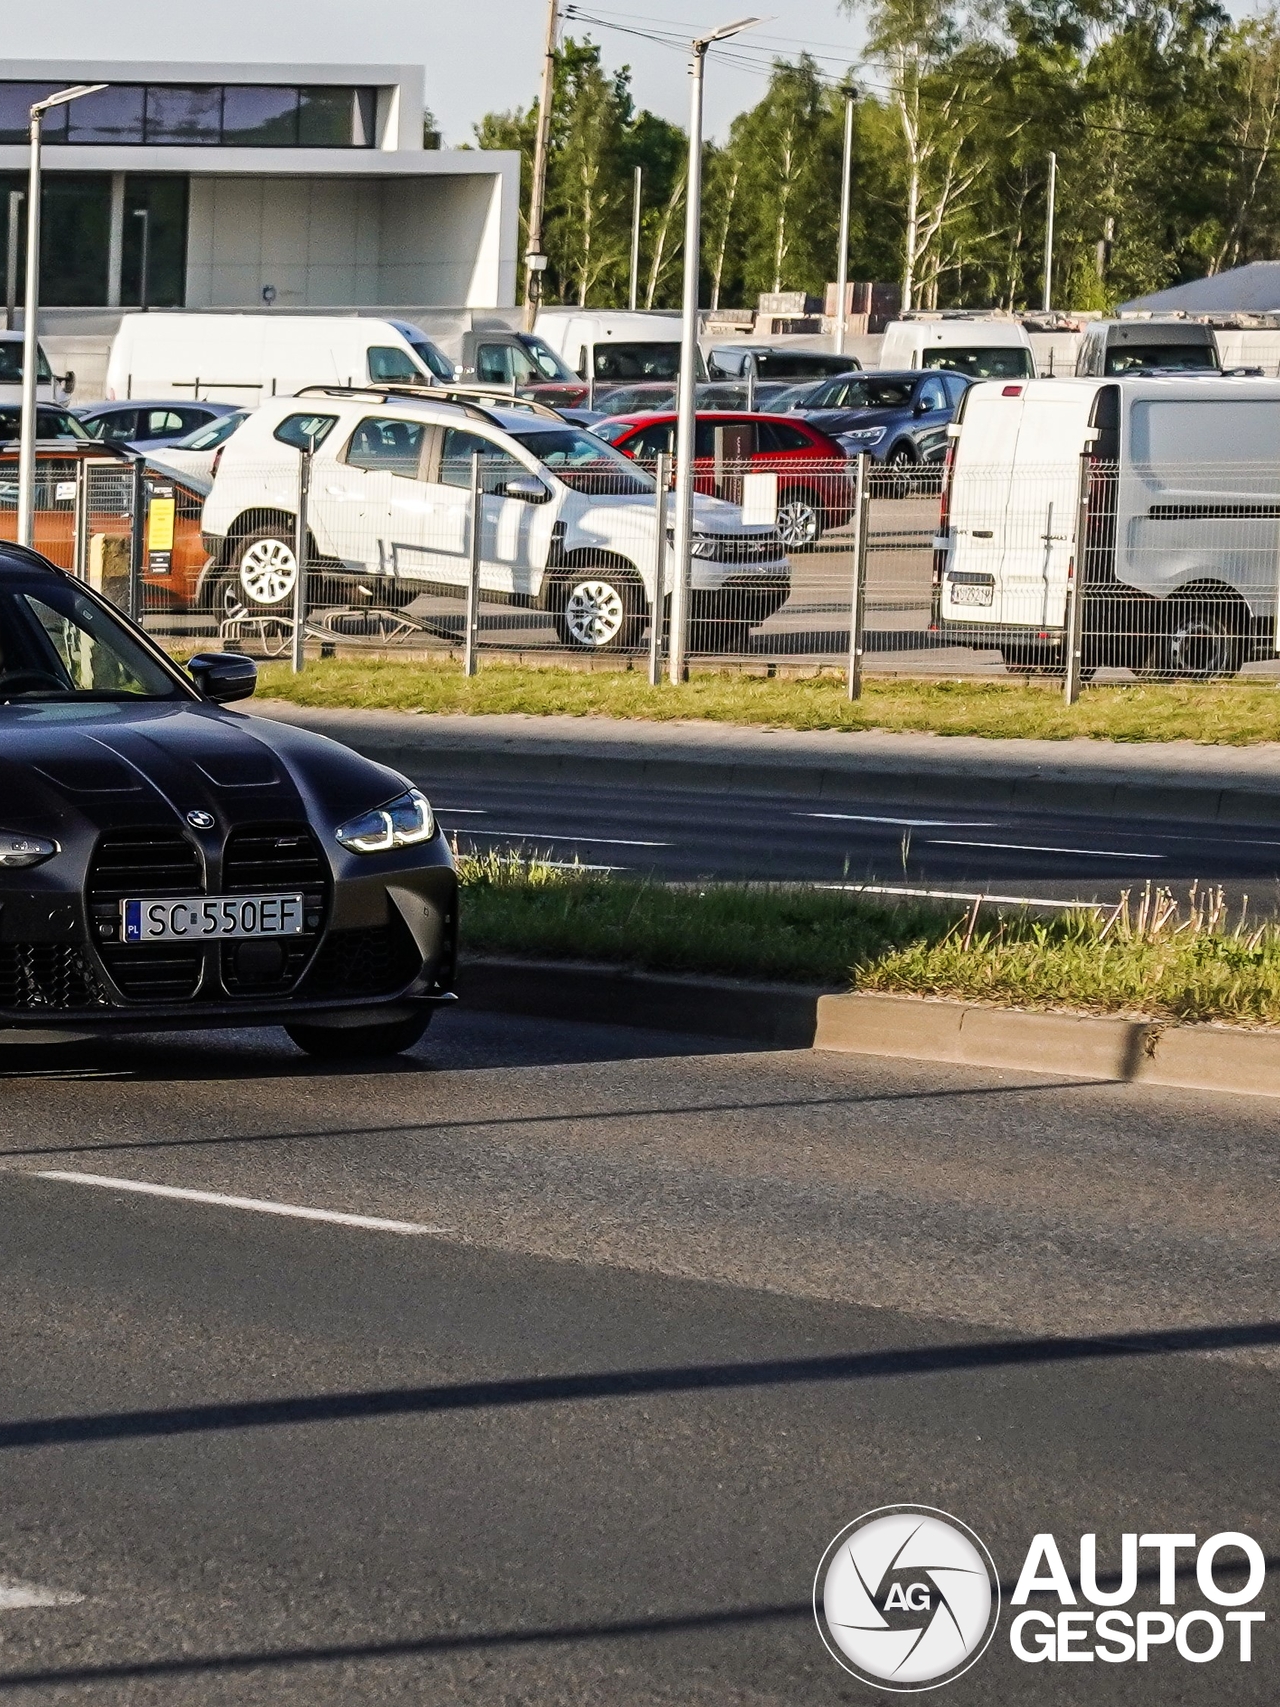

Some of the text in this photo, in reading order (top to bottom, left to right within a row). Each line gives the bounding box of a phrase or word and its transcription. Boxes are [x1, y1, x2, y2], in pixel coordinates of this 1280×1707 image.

[147, 899, 298, 936] SC 550EF
[128, 925, 139, 934] PL
